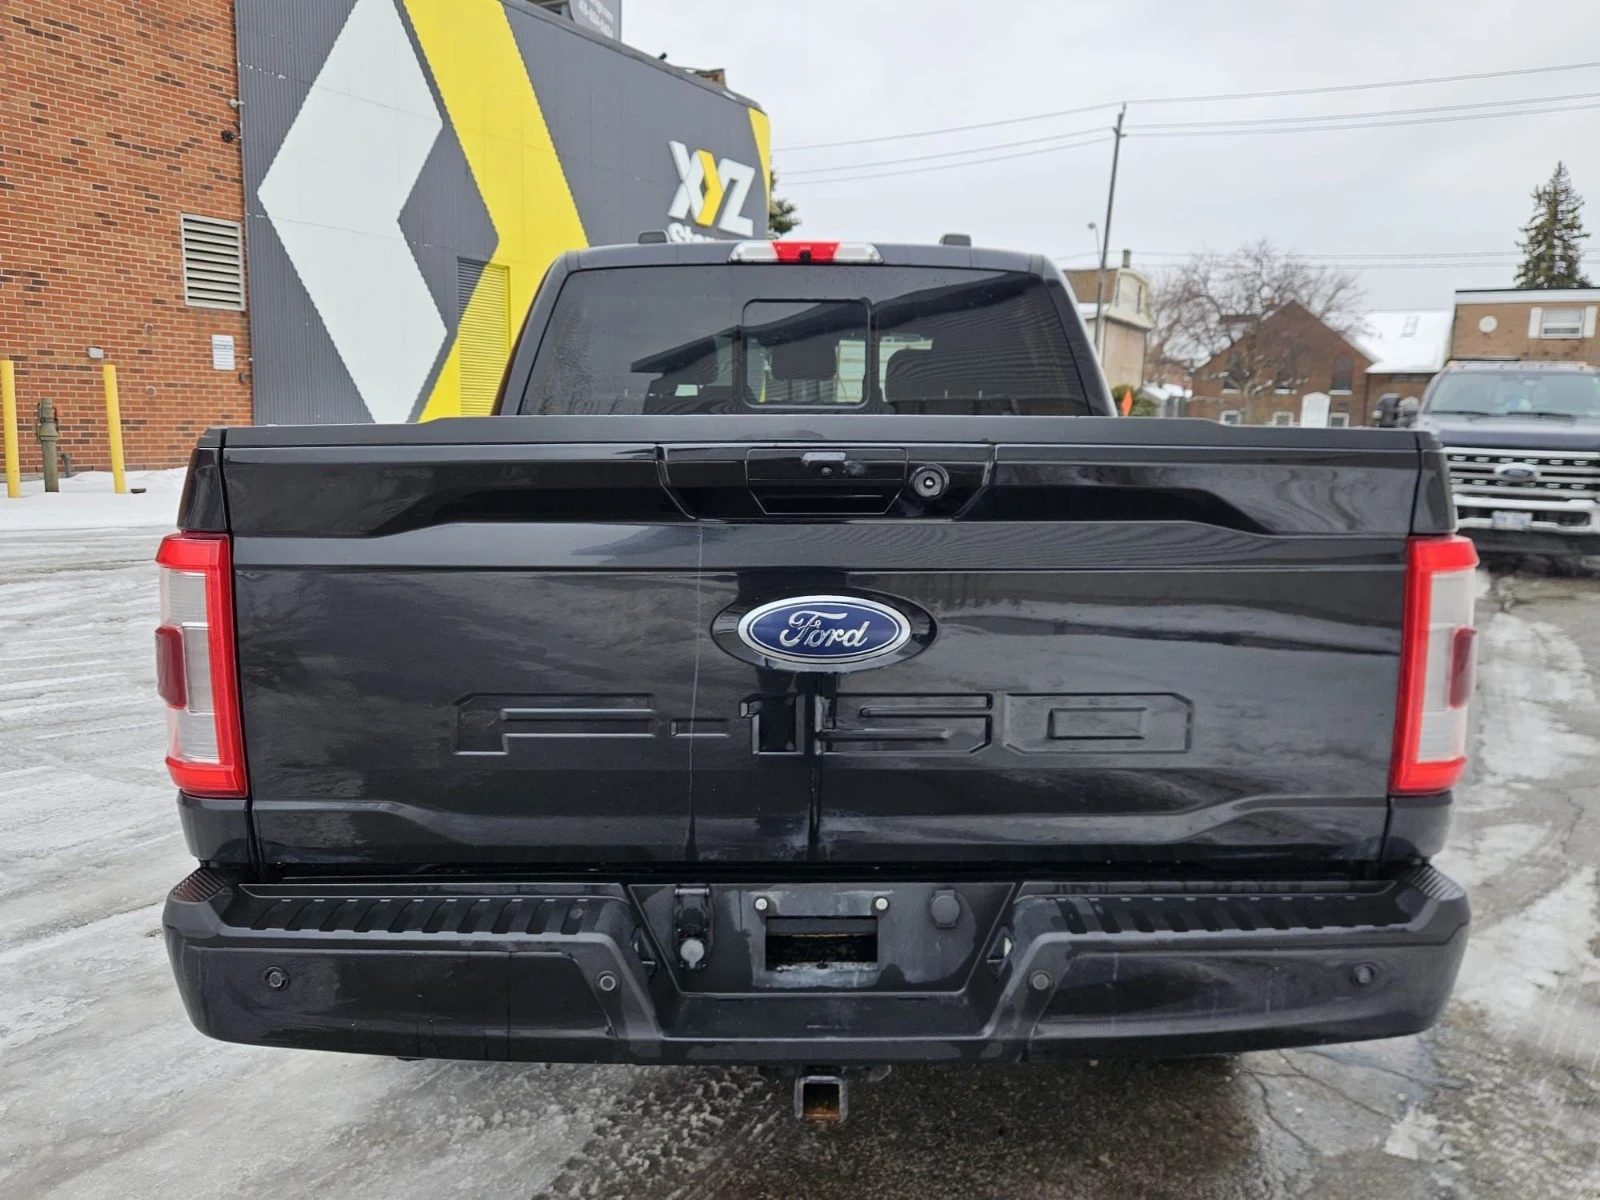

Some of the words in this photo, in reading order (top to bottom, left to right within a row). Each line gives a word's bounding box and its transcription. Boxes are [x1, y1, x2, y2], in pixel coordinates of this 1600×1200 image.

[668, 140, 755, 237] XYZ
[779, 610, 870, 648] Ford
[452, 692, 1193, 755] F-150
